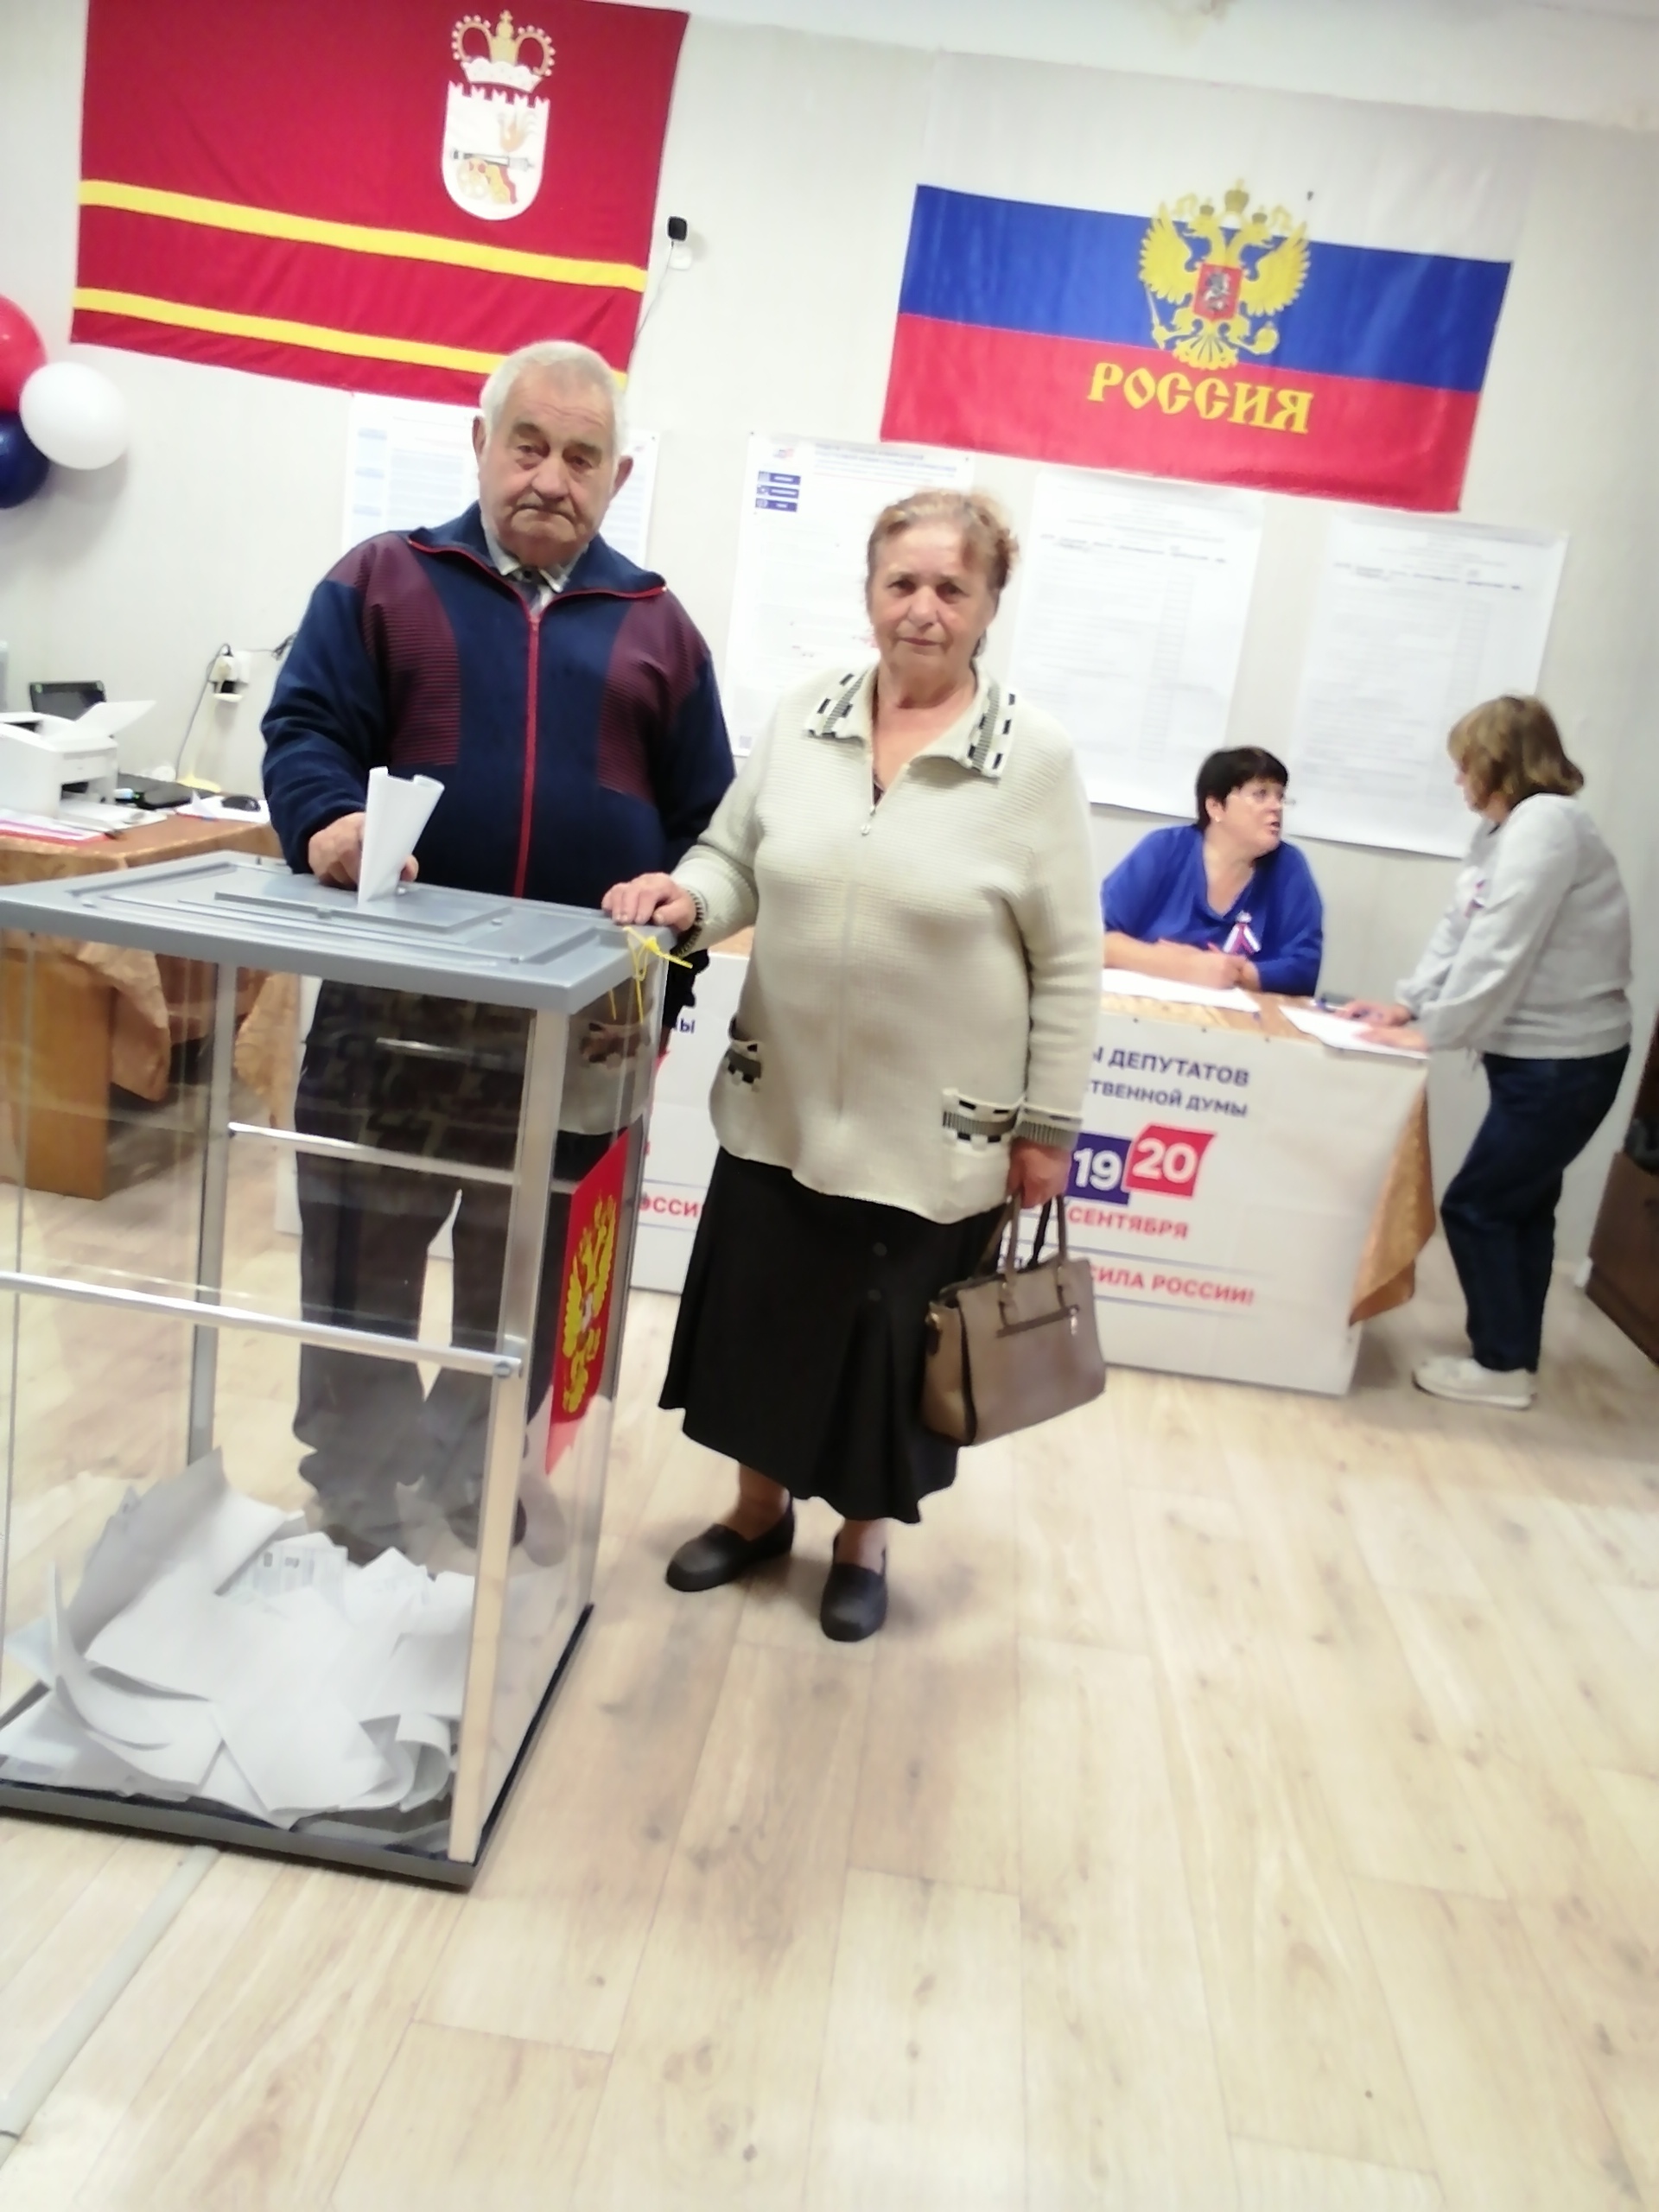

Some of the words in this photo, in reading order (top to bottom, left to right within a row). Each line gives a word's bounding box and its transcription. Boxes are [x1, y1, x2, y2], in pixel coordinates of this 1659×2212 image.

[1087, 362, 1313, 434] РОССИЯ
[1108, 1048, 1249, 1087] ДЕПУТАТОВ
[1089, 1079, 1183, 1108] ТВЕННОЙ
[1185, 1094, 1248, 1117] ДУМЫ
[1073, 1147, 1122, 1192] 19
[1132, 1137, 1198, 1185] 20
[1068, 1207, 1189, 1240] СЕНТЯБРЯ
[1151, 1274, 1255, 1306] РОССИИ!
